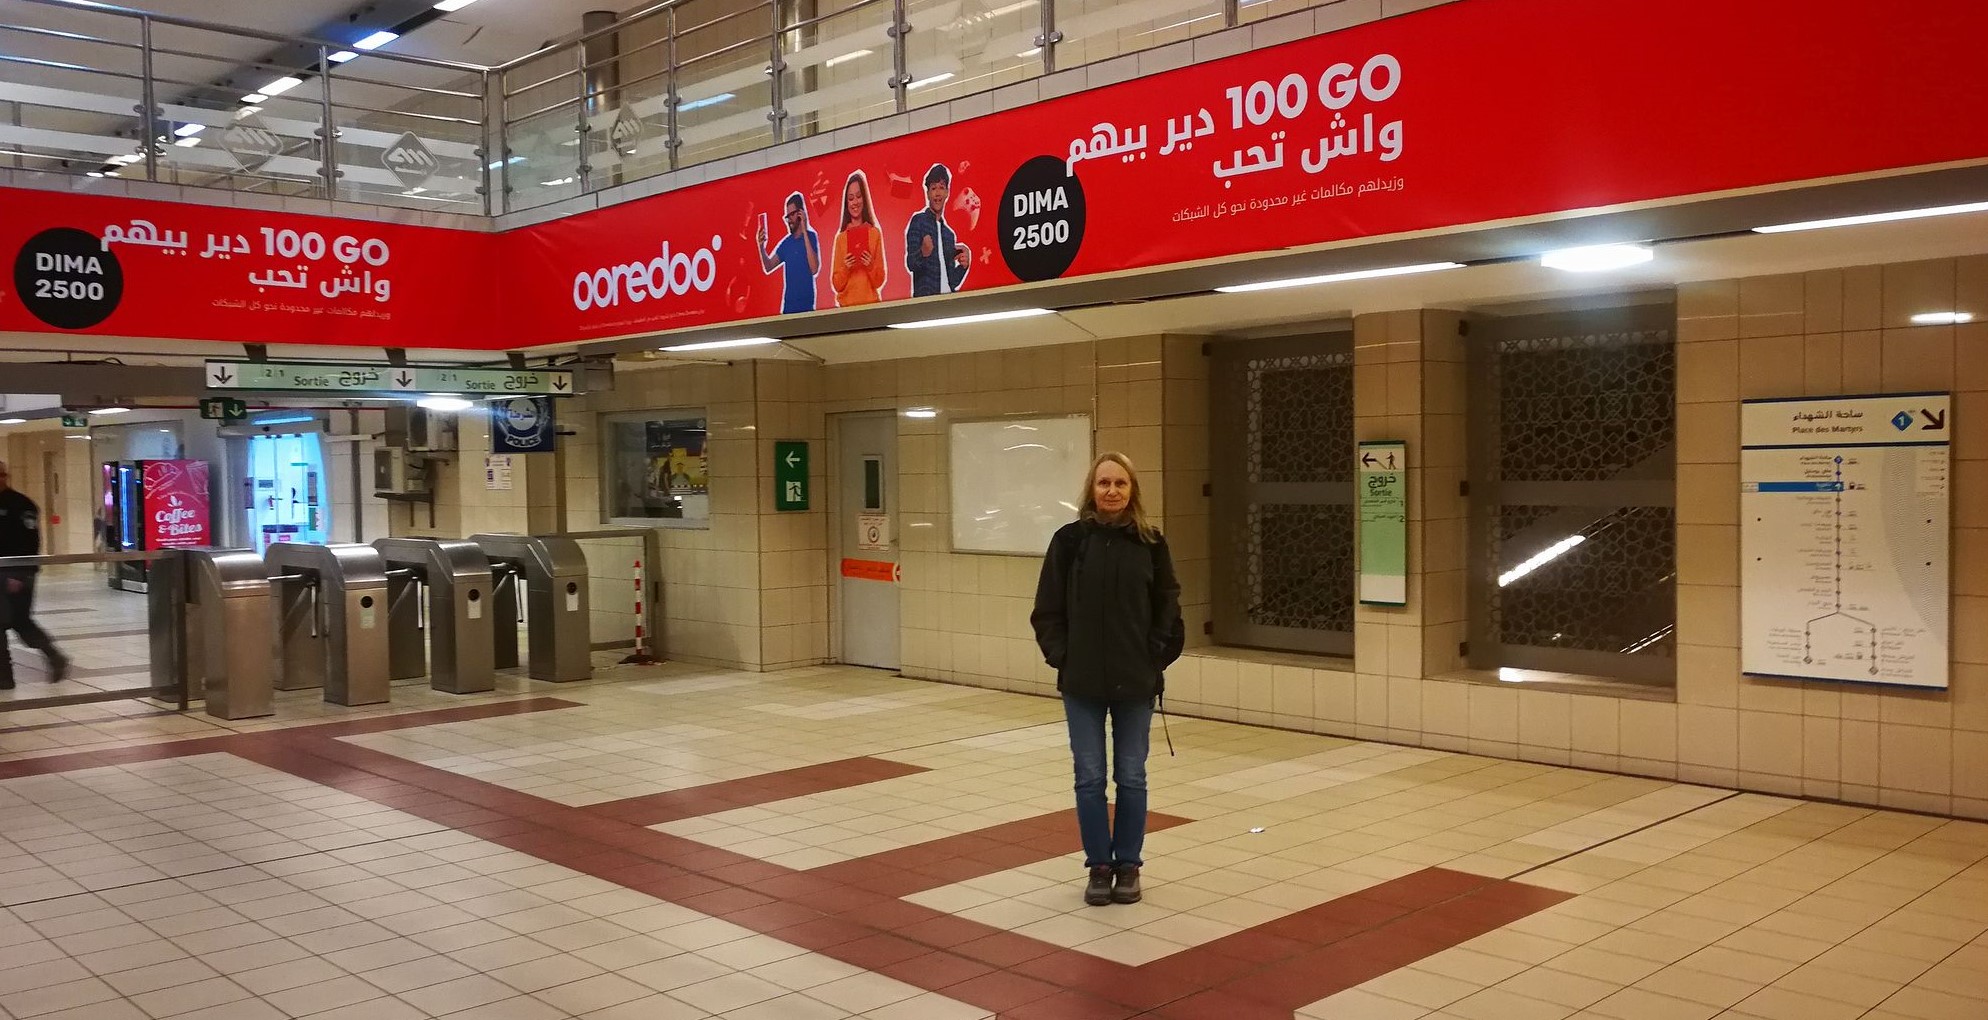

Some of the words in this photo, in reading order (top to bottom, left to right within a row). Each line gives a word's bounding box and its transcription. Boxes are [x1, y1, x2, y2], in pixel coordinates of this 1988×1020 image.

[1319, 54, 1402, 110] GO
[1226, 74, 1308, 129] 100
[1159, 108, 1215, 156] دير
[1066, 122, 1147, 177] بيهم
[1301, 113, 1403, 174] واش
[1213, 131, 1286, 188] تحب
[1310, 183, 1354, 200] مكالمات
[1357, 176, 1404, 199] وزيدلهم
[1013, 186, 1069, 218] DIMA
[1230, 201, 1246, 216] نحو
[1250, 196, 1289, 212] محدودة
[1291, 190, 1308, 207] غير
[1172, 205, 1210, 222] الشبكات
[1213, 202, 1227, 219] كل
[100, 219, 188, 256] بيهم
[261, 227, 326, 261] 100
[1013, 219, 1070, 251] 2500
[199, 234, 251, 260] دير
[332, 235, 390, 267] GO
[35, 252, 104, 275] DIMA
[248, 264, 309, 293] تحب
[319, 265, 391, 302] واش
[573, 240, 717, 311] ooredoo
[35, 279, 104, 301] 2500
[294, 375, 330, 387] Sortie
[338, 367, 380, 387] خروج
[465, 379, 496, 391] Sortie
[503, 371, 539, 390] خروج
[1792, 409, 1834, 422] الشهداء
[1836, 409, 1864, 419] ساحة
[1792, 426, 1814, 434] Place
[1815, 425, 1830, 434] des
[1831, 424, 1864, 434] Martyrs
[507, 435, 541, 447] POLICE
[1368, 473, 1397, 489] خروج
[1370, 489, 1393, 497] Sortie
[155, 508, 196, 523] Coffee
[168, 523, 203, 536] Bites
